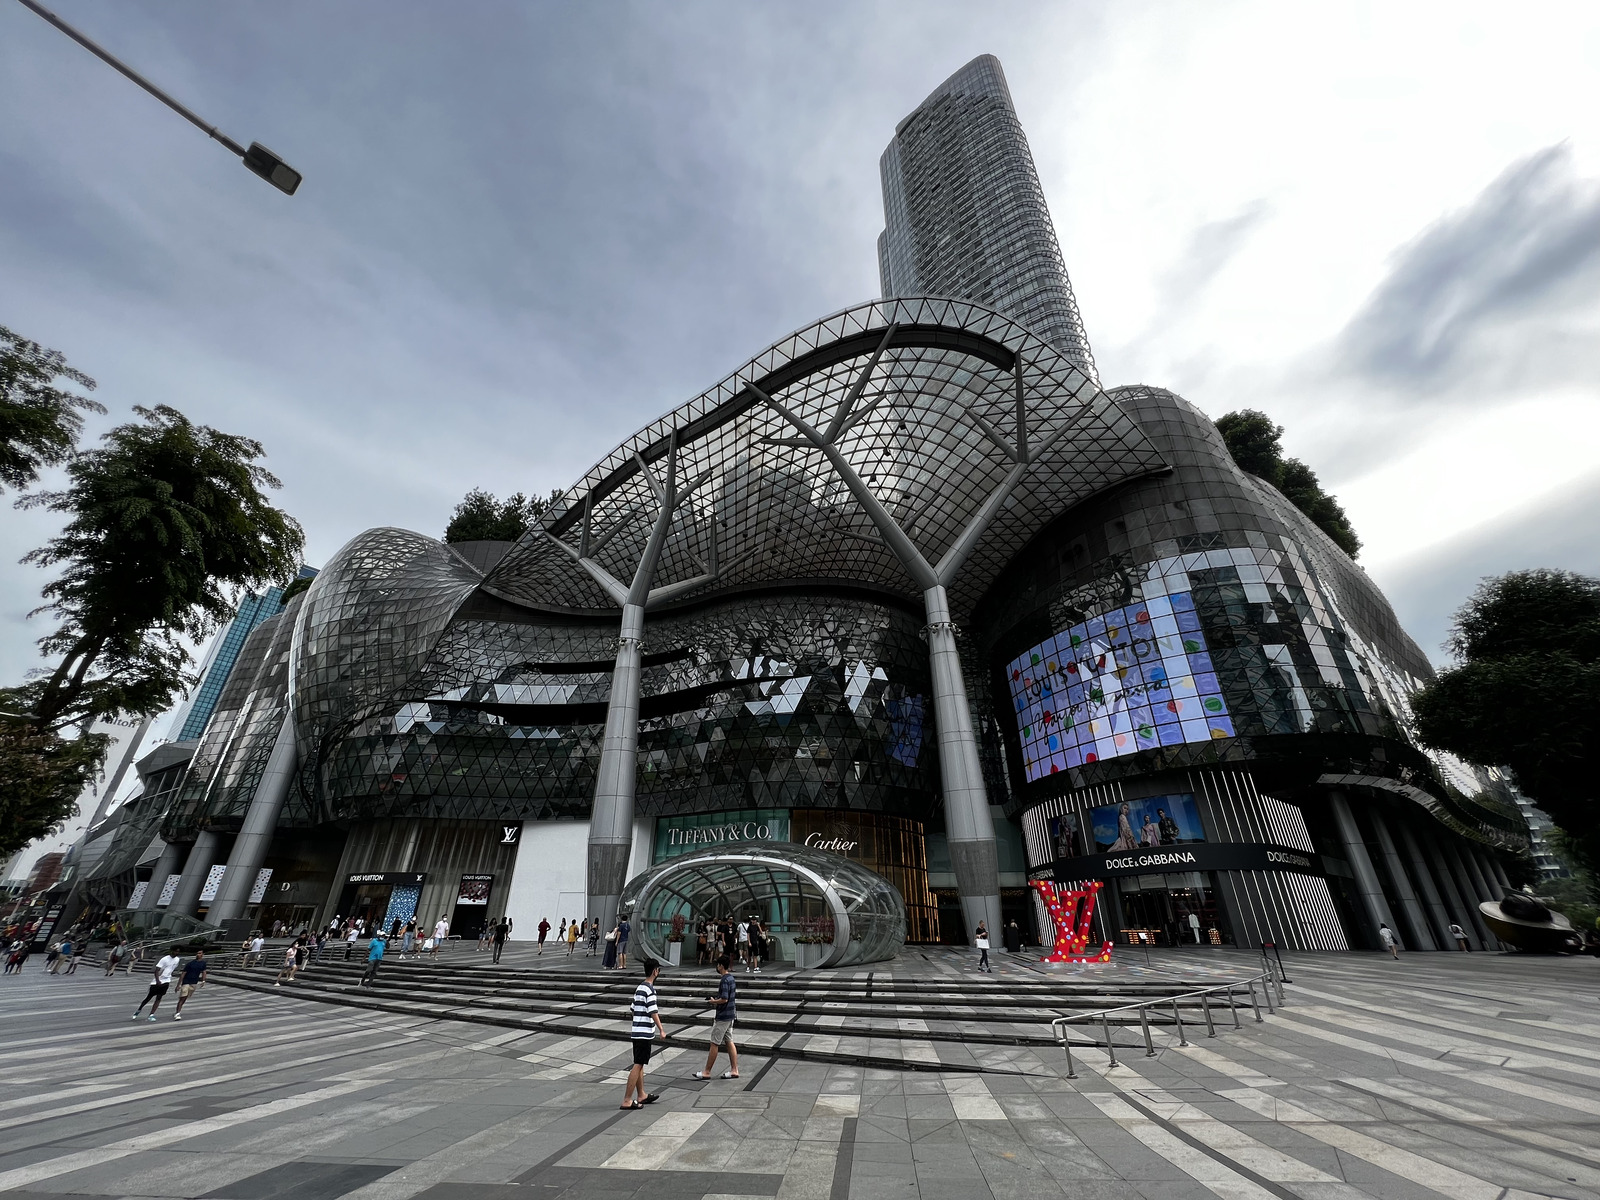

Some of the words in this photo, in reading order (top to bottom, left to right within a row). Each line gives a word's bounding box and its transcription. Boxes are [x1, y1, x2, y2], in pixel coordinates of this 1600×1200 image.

[1071, 632, 1174, 672] UTON
[668, 827, 727, 845] TIFFANY
[728, 824, 740, 841] &
[804, 831, 858, 851] Cartier
